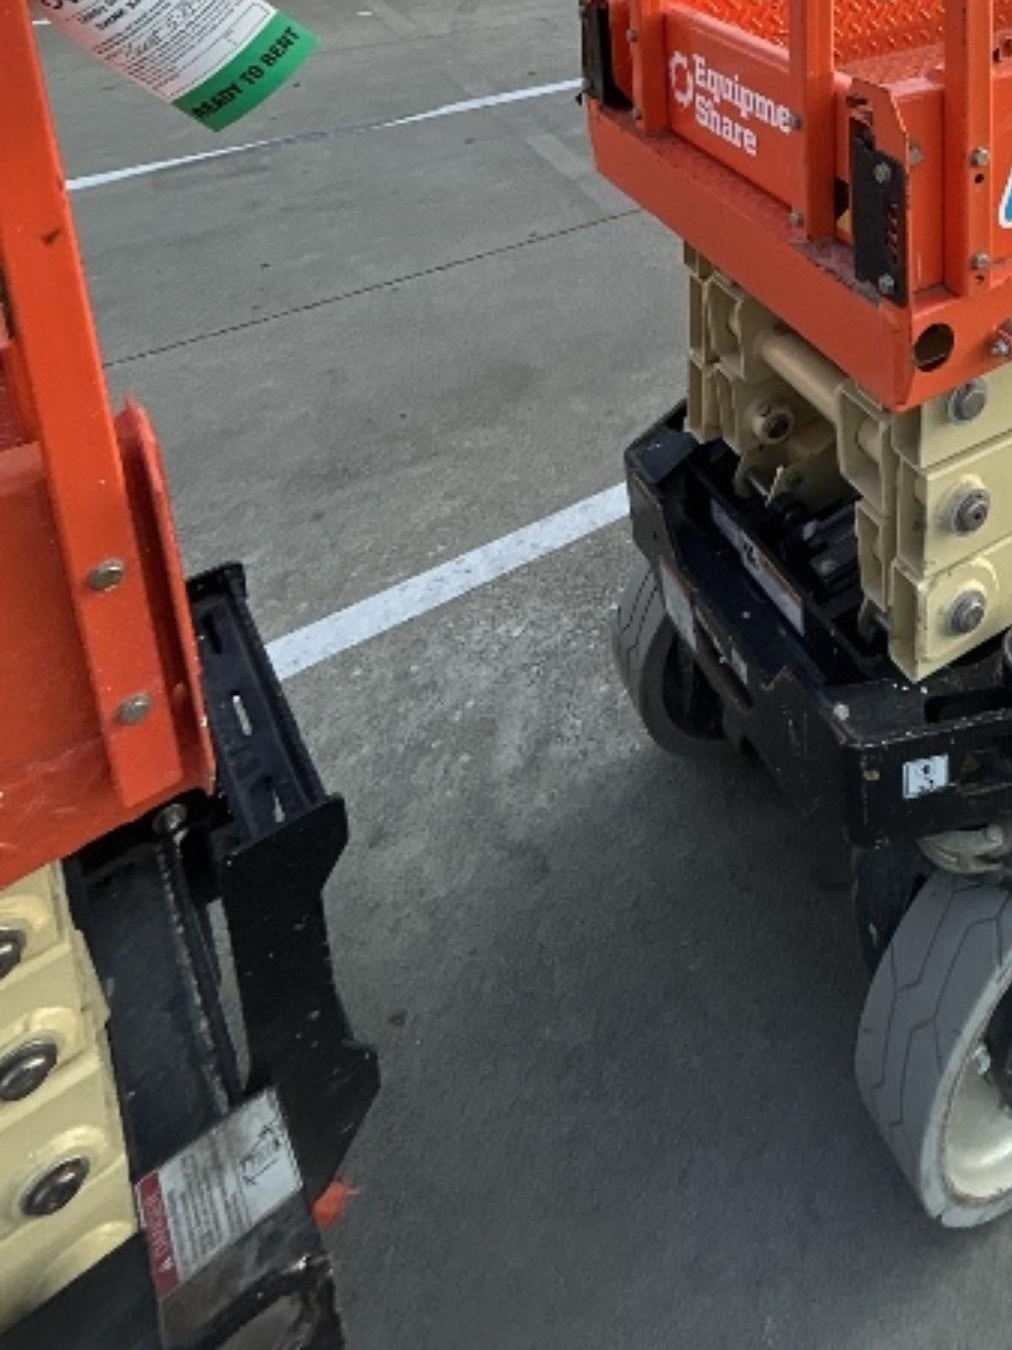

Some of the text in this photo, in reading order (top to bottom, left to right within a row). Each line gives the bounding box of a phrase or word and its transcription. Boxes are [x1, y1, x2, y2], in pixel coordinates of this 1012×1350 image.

[240, 65, 264, 85] TO
[693, 53, 793, 134] Equipme
[695, 93, 757, 156] Share
